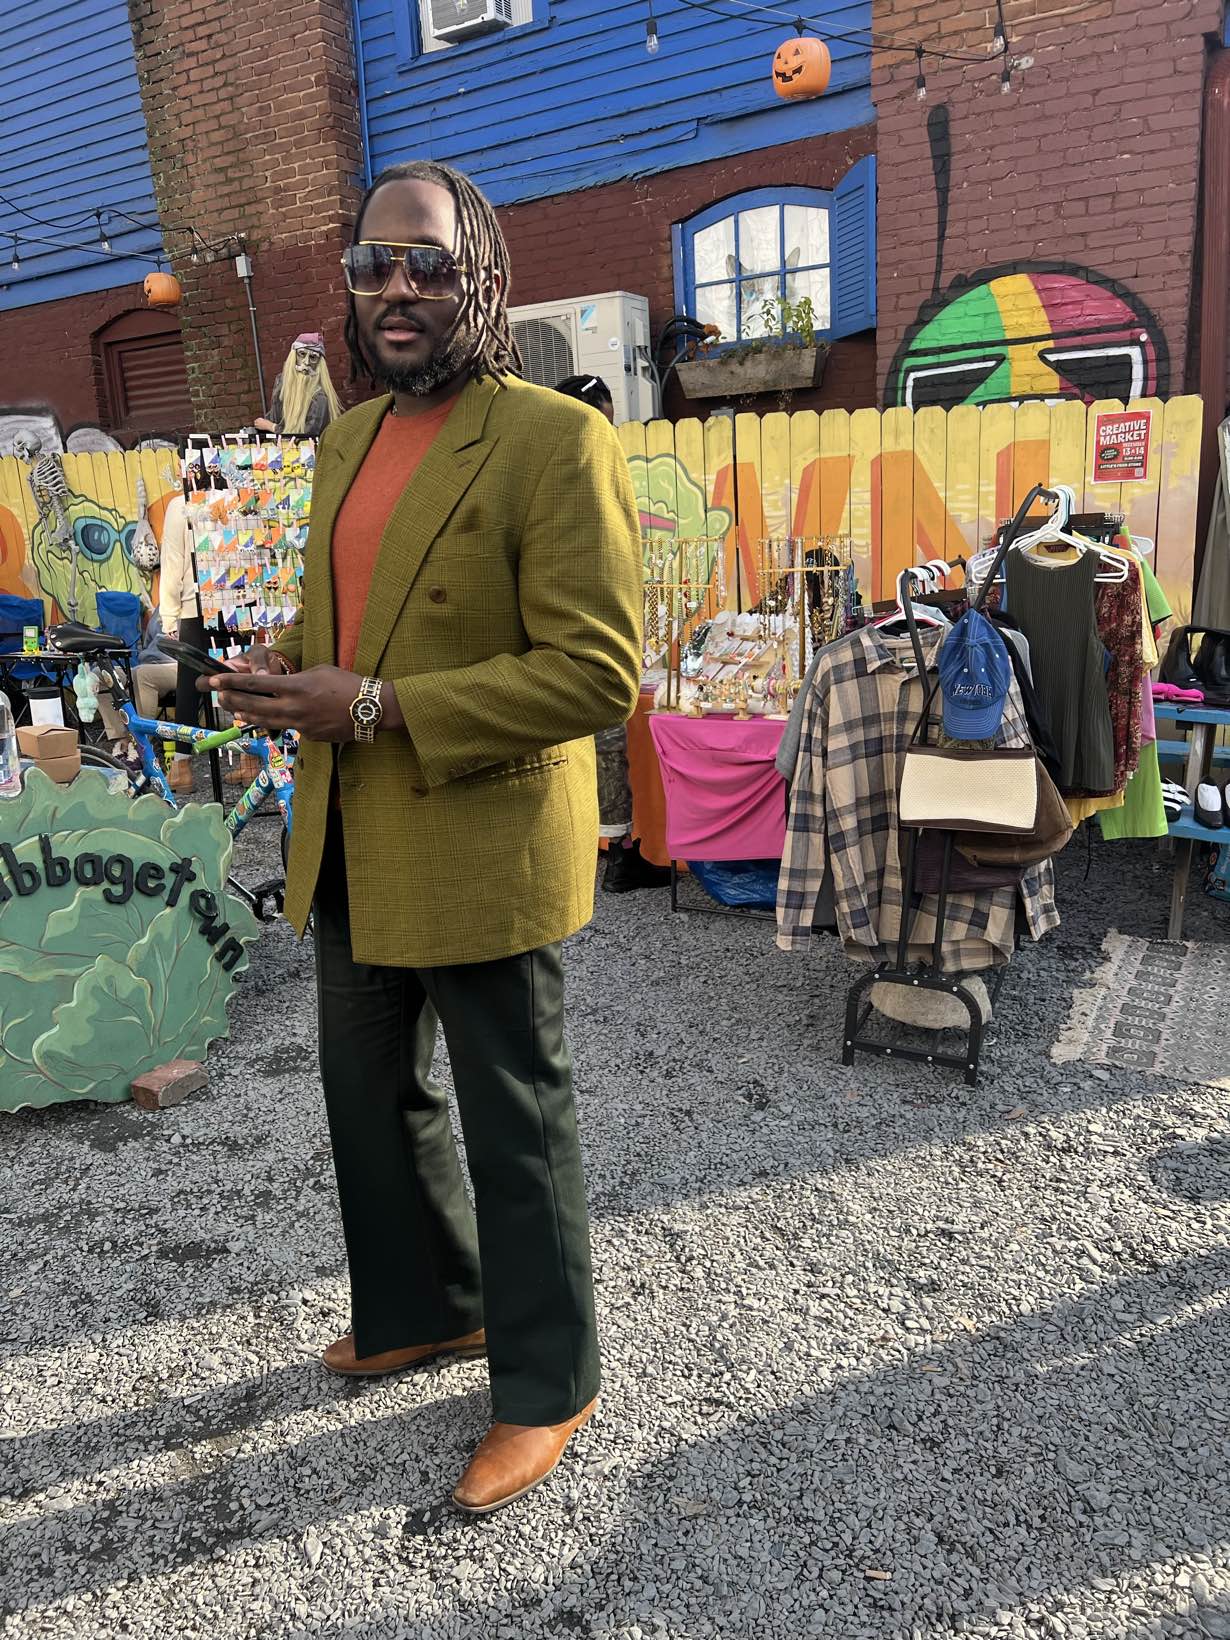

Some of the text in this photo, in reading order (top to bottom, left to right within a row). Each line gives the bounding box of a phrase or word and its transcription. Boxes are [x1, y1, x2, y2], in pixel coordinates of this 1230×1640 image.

[1100, 420, 1147, 436] CREATIVE
[1100, 430, 1147, 446] MARKET
[0, 833, 245, 972] bbagetown
